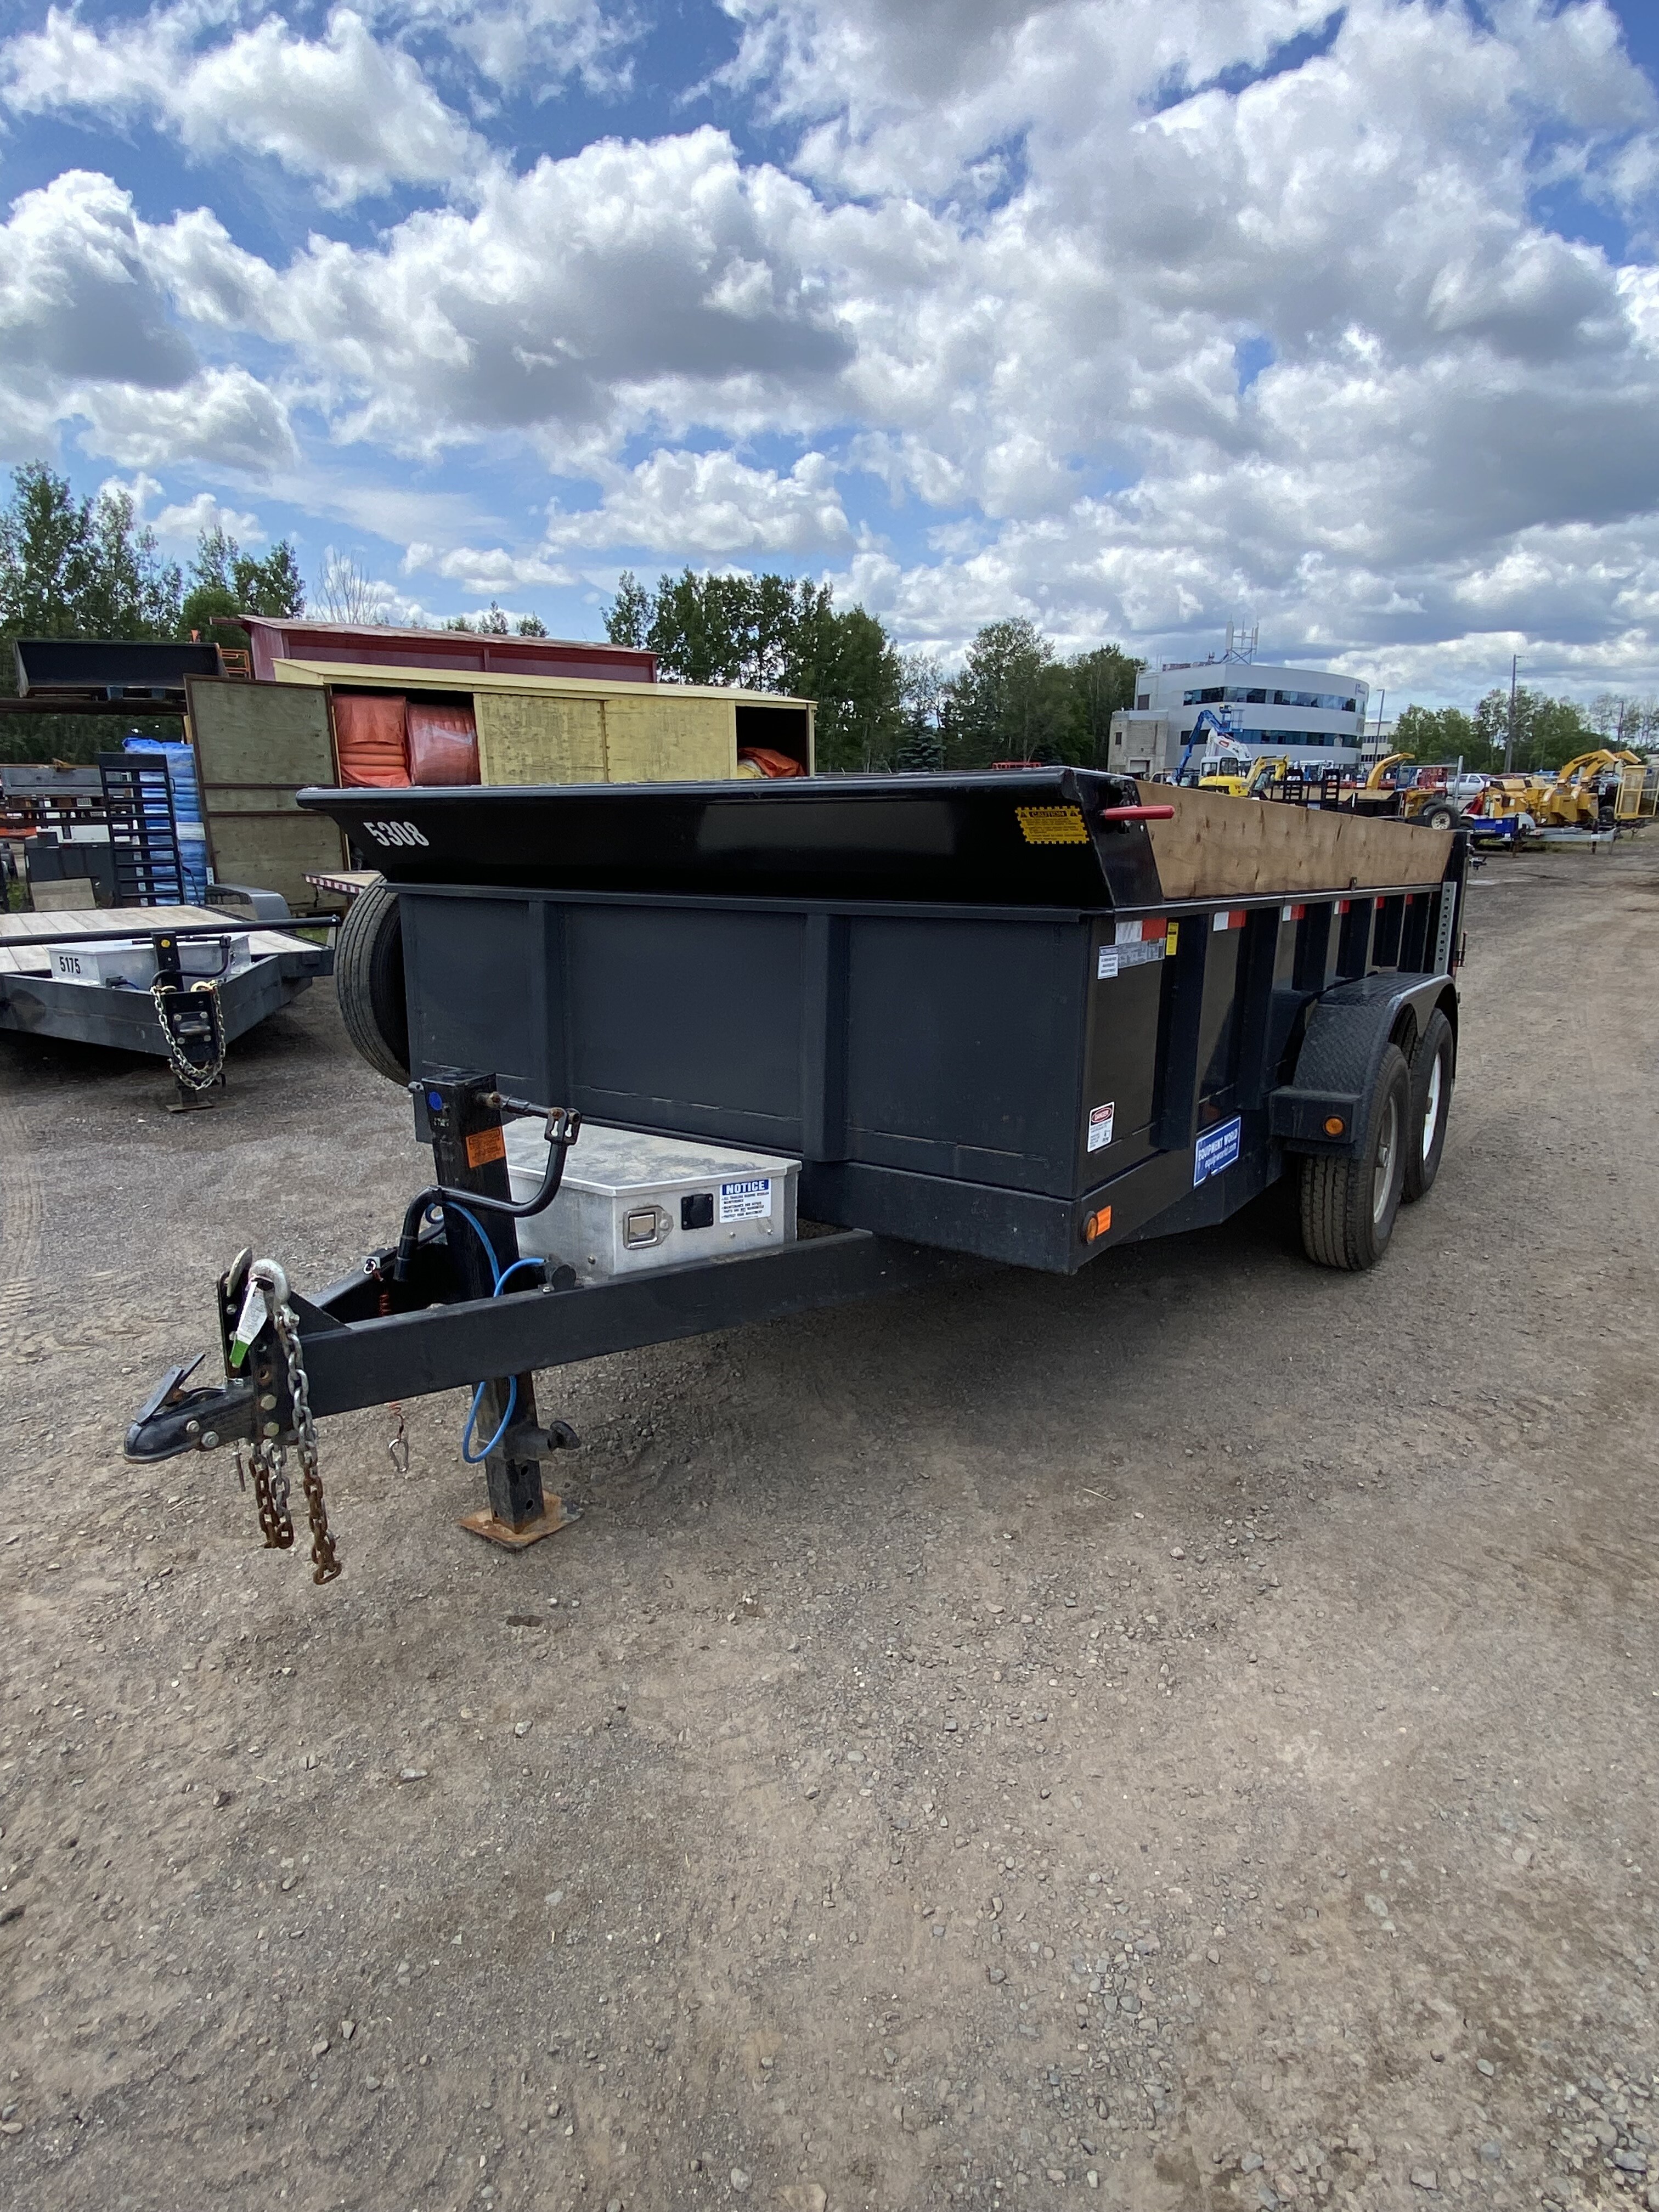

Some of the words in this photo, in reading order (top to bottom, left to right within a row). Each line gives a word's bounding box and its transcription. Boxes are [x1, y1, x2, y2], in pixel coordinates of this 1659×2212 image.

[363, 821, 430, 846] 5308
[59, 956, 81, 974] 5175
[1198, 1137, 1223, 1161] EQUIPMENT
[1224, 1128, 1238, 1146] WORLD
[726, 1181, 765, 1194] NOTICE
